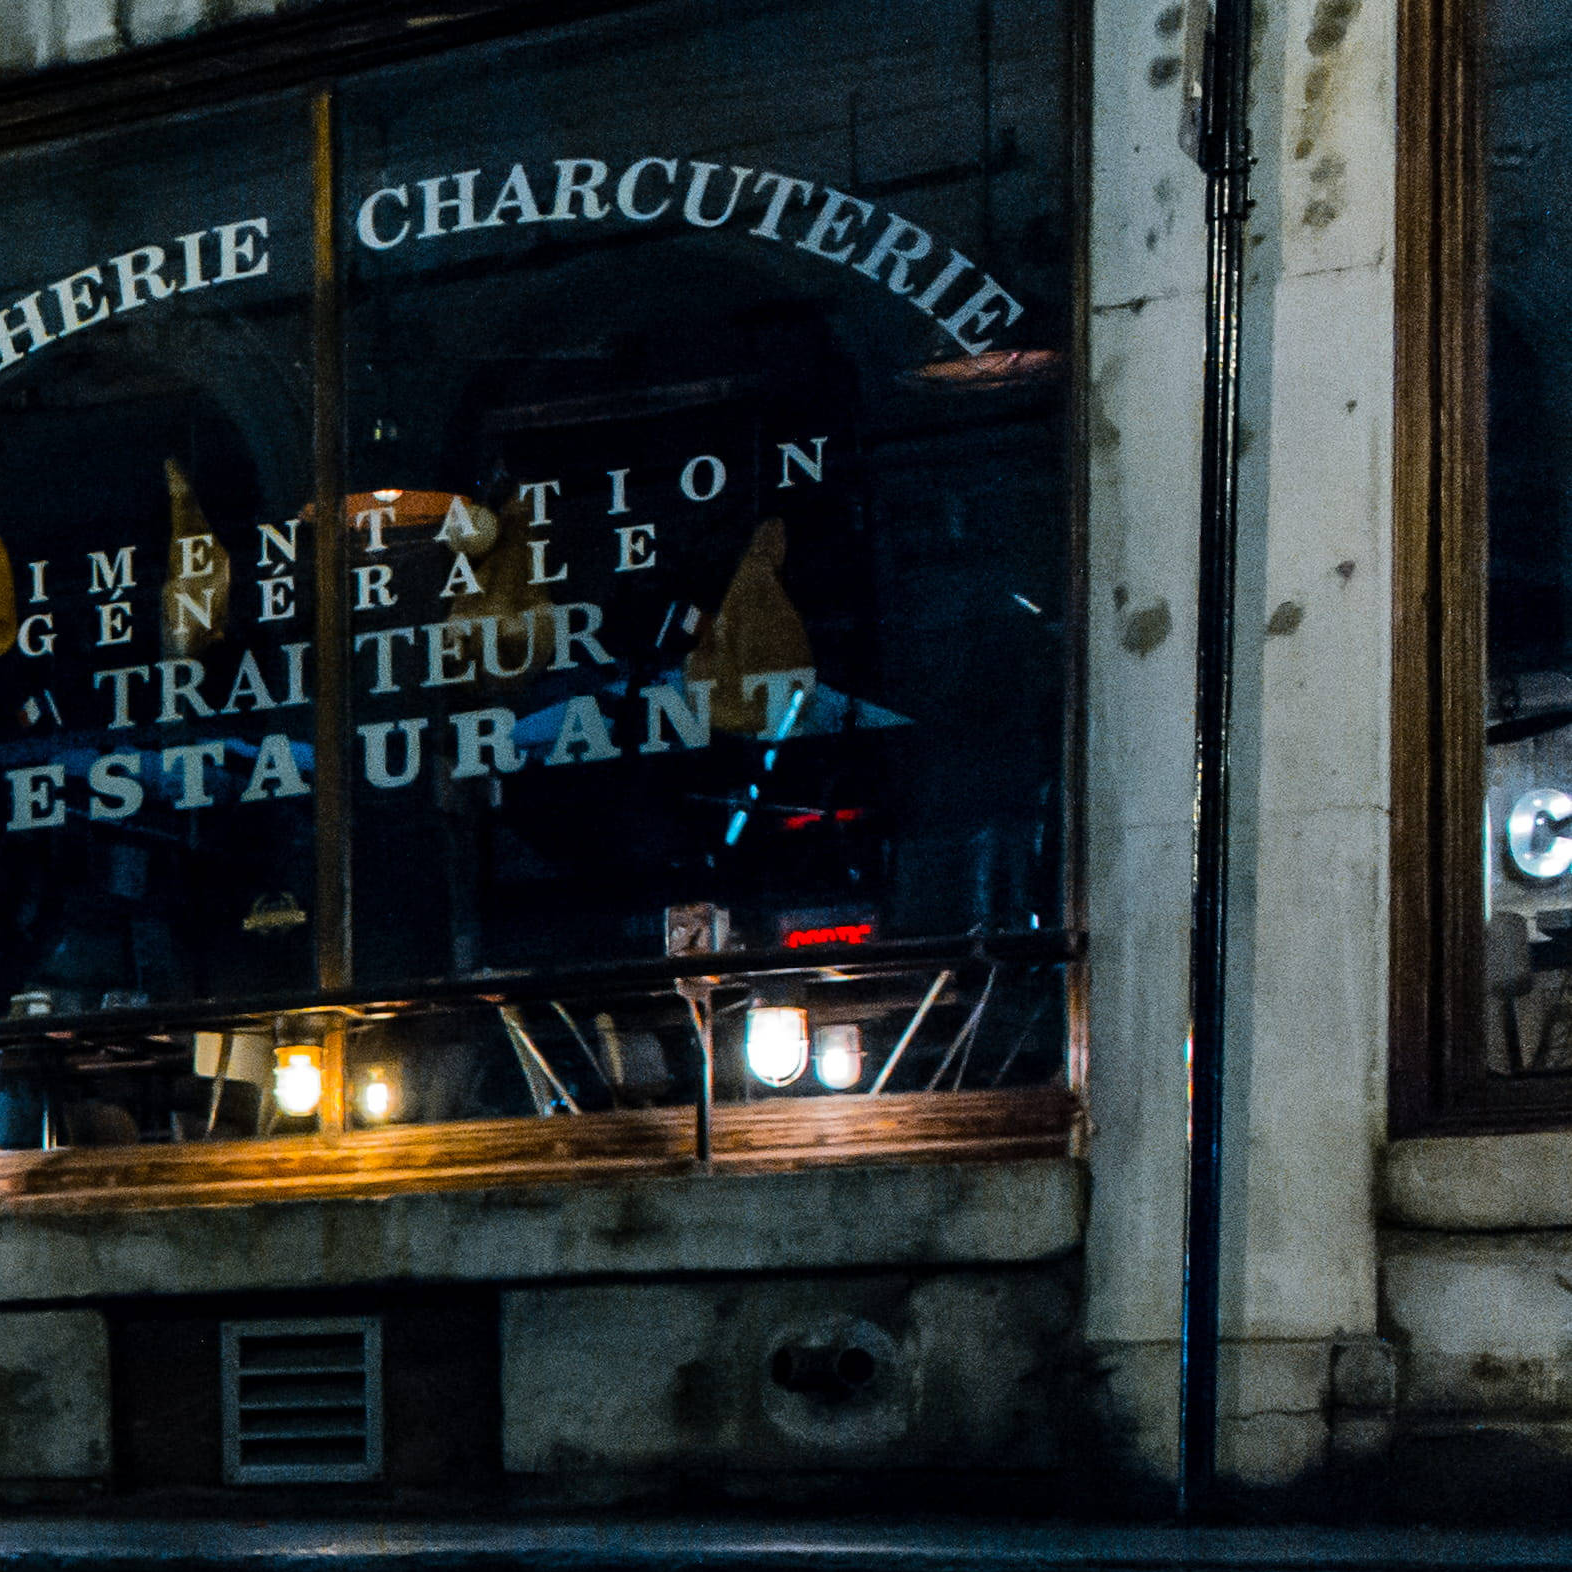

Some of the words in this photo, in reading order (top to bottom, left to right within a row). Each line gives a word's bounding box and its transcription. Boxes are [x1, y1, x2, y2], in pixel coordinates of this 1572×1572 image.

[355, 157, 1025, 358] CHARCUTERIE
[15, 520, 659, 657] GÉNÉRALE
[93, 602, 615, 732] TRAITEUR
